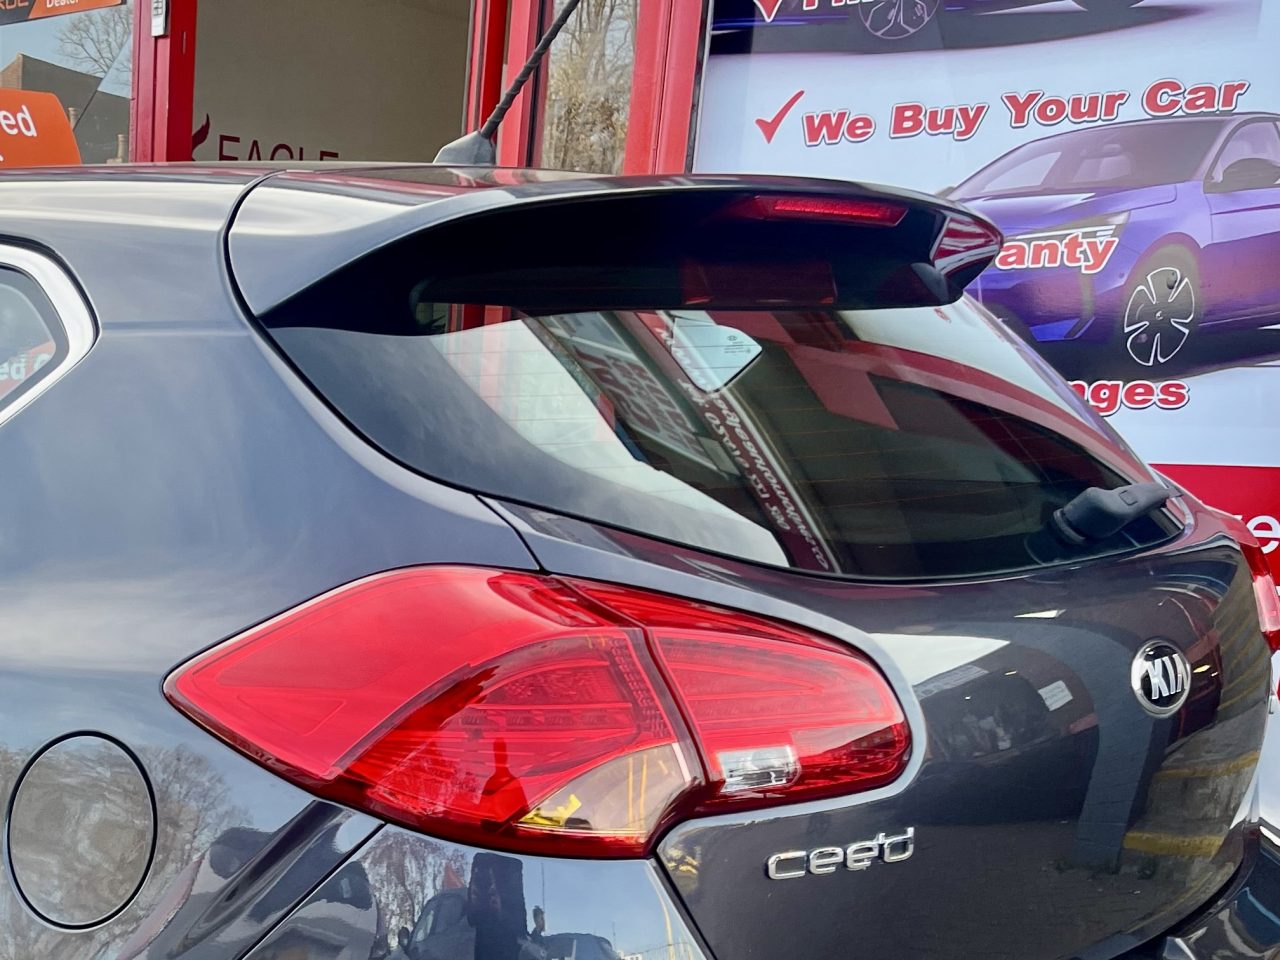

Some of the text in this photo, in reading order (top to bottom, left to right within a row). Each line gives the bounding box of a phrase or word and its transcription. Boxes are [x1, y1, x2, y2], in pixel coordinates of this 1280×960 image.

[803, 79, 1250, 146] We Buy Your Car
[1147, 652, 1190, 700] KIA
